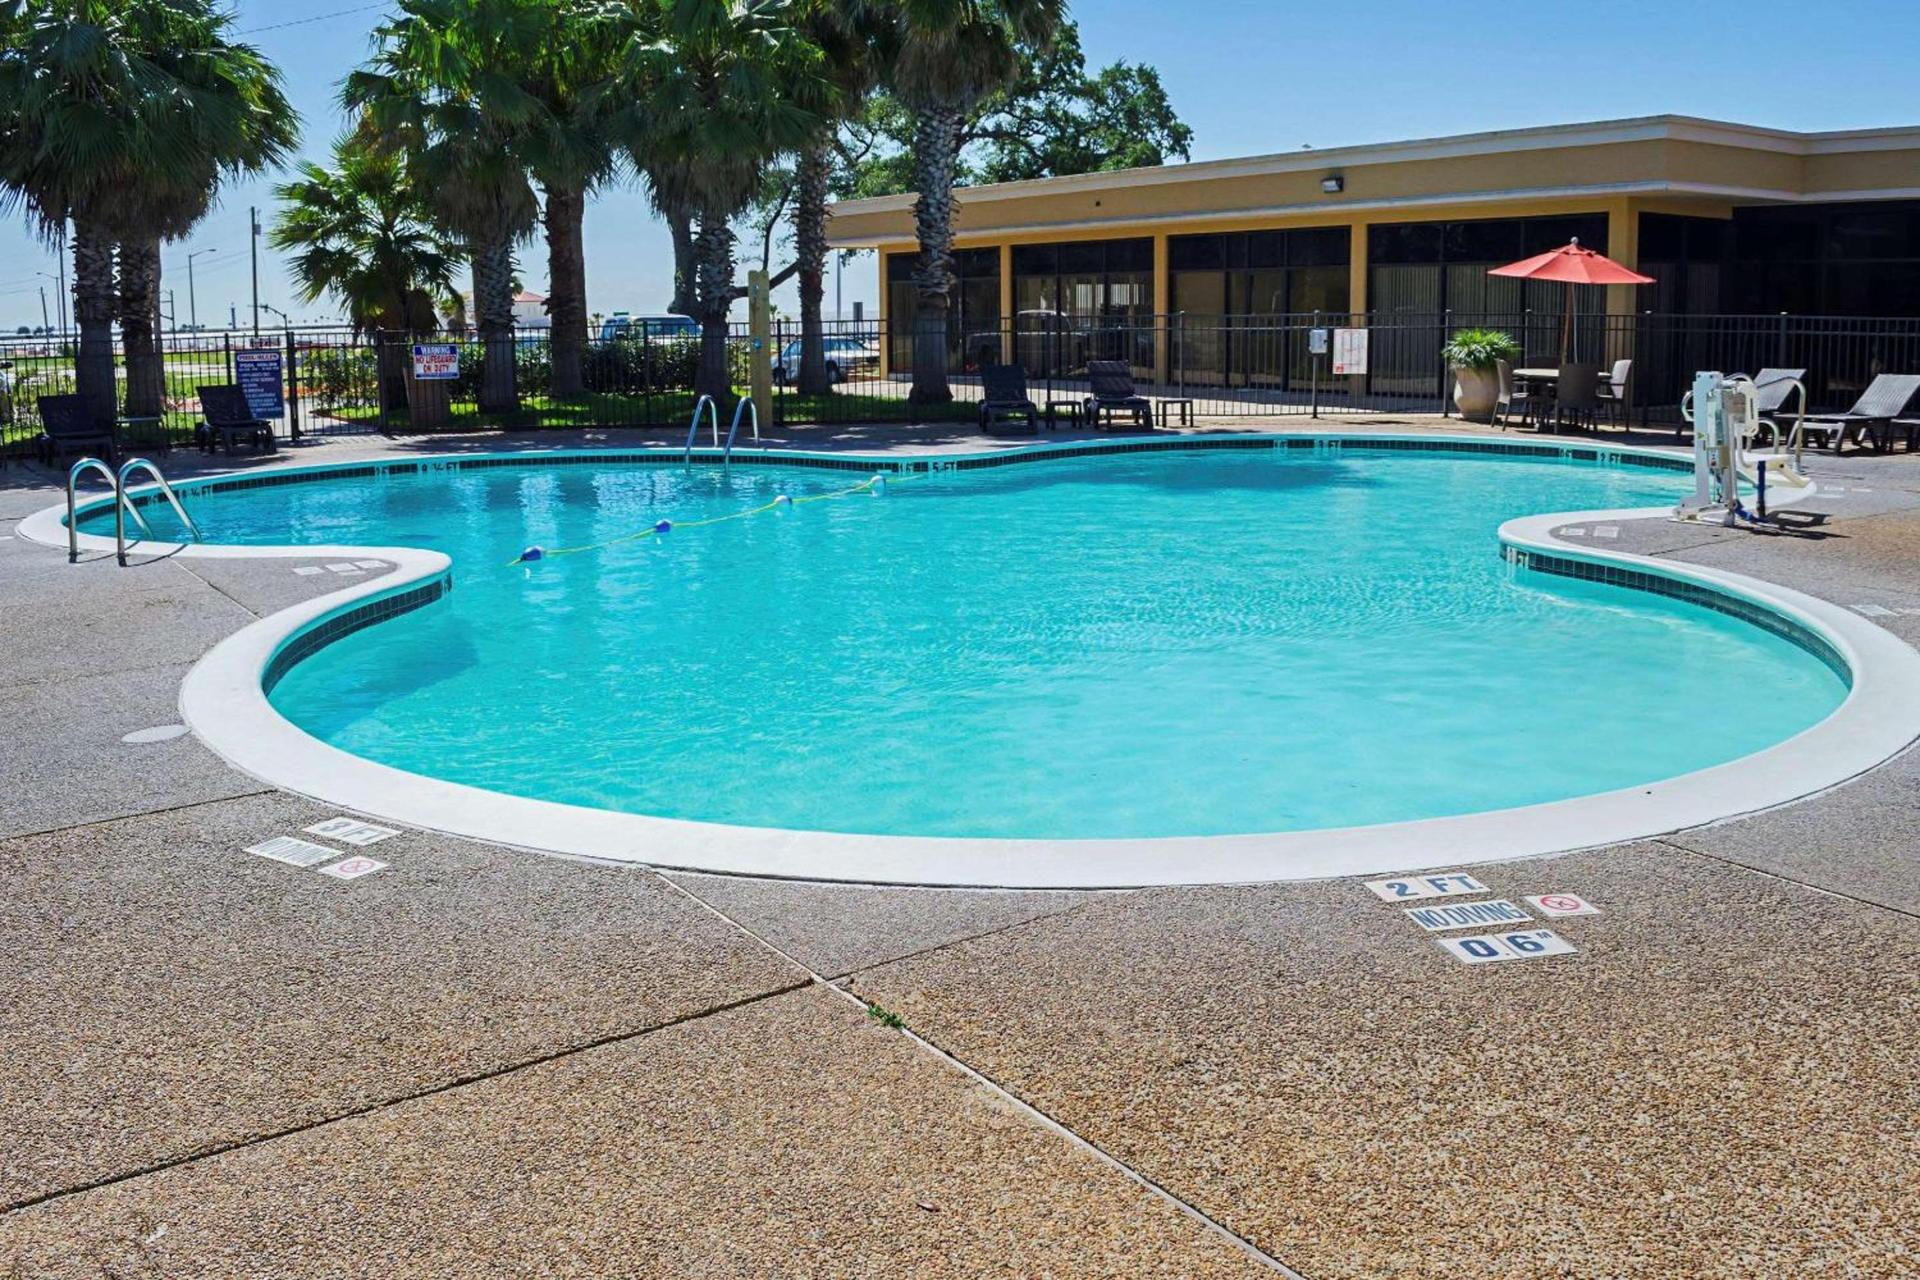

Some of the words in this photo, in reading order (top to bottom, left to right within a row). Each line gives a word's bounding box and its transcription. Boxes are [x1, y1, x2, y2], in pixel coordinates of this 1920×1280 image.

[1385, 882, 1420, 897] 2
[1410, 907, 1448, 928] NO
[1447, 902, 1529, 925] DIVING
